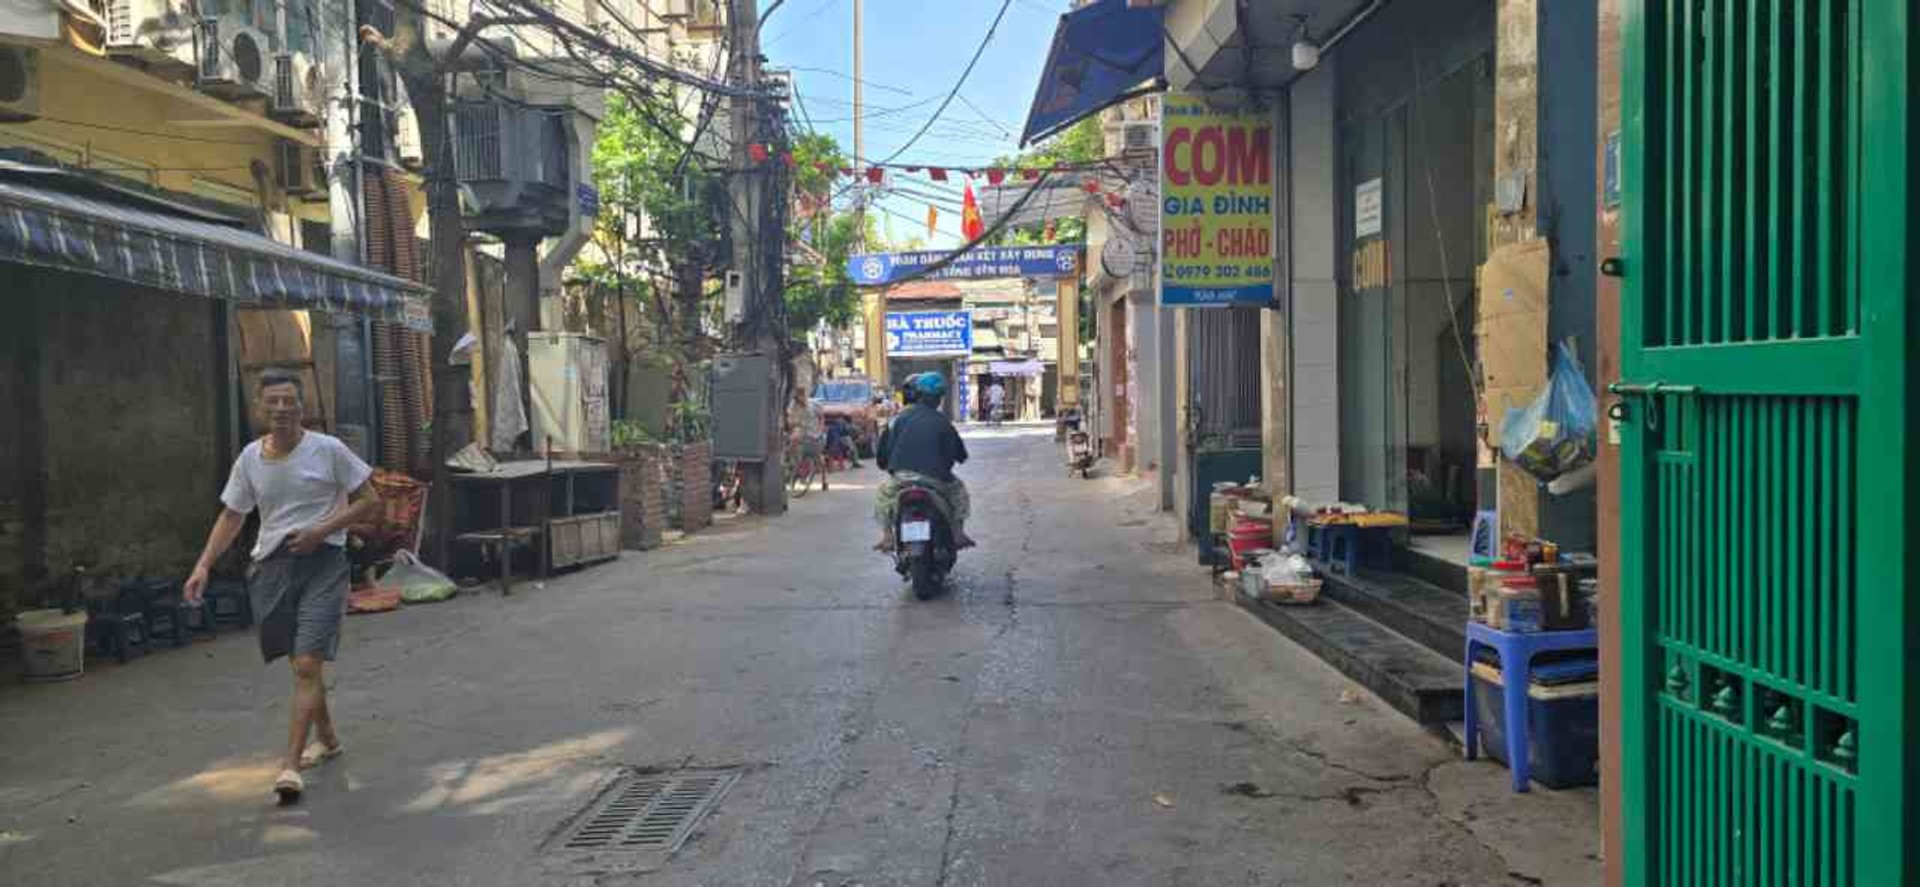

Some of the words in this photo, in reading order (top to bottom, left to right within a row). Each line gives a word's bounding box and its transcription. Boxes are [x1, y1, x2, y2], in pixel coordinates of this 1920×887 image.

[1164, 126, 1271, 186] CƠM
[1164, 196, 1203, 215] GIA
[1213, 191, 1270, 215] ĐÌNH
[1217, 221, 1270, 259] CHÁO
